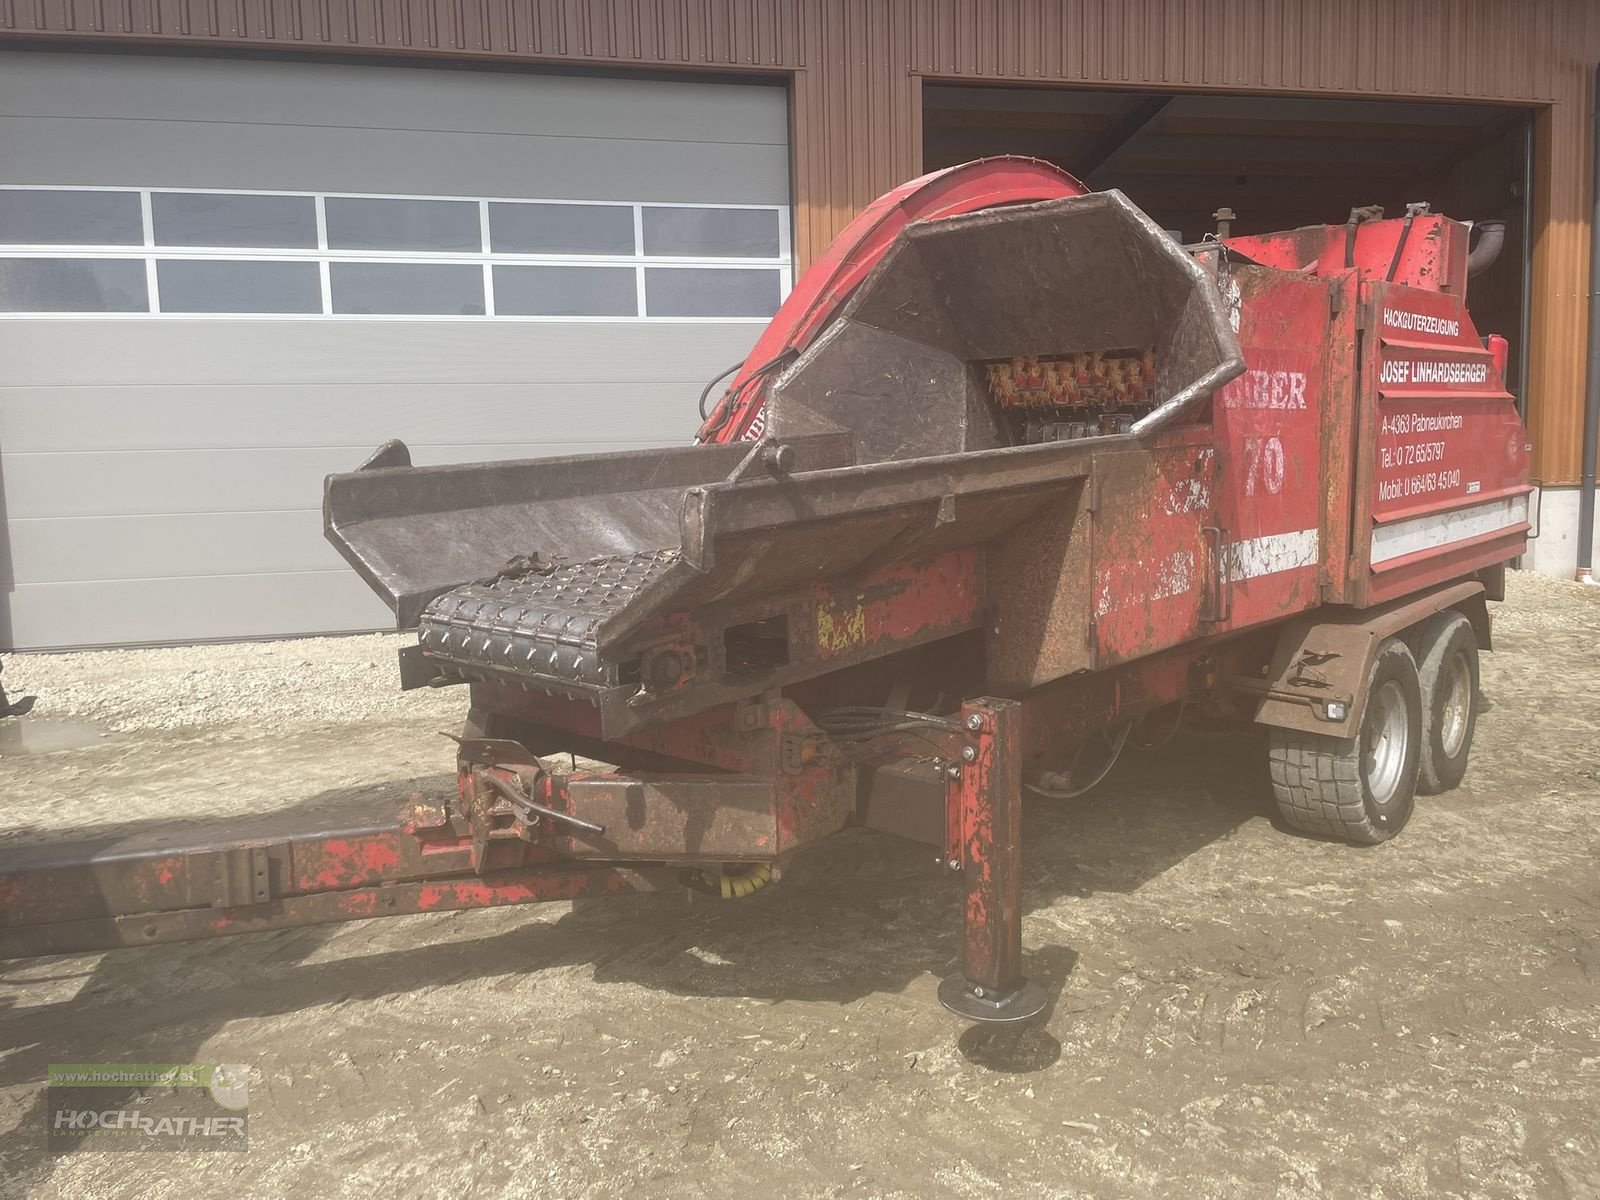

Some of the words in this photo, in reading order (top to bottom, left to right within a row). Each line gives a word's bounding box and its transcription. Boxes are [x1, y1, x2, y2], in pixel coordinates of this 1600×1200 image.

[1383, 308, 1459, 336] HACKGUTERZEUGUNG
[1380, 360, 1409, 383] JOSEF
[1411, 361, 1486, 383] LINHARDSBERGER
[1381, 414, 1410, 435] A-4363
[1411, 411, 1463, 432] Pabneukirchen
[1396, 446, 1403, 466] 0
[1405, 445, 1414, 465] 72
[1379, 478, 1403, 501] Mobil:
